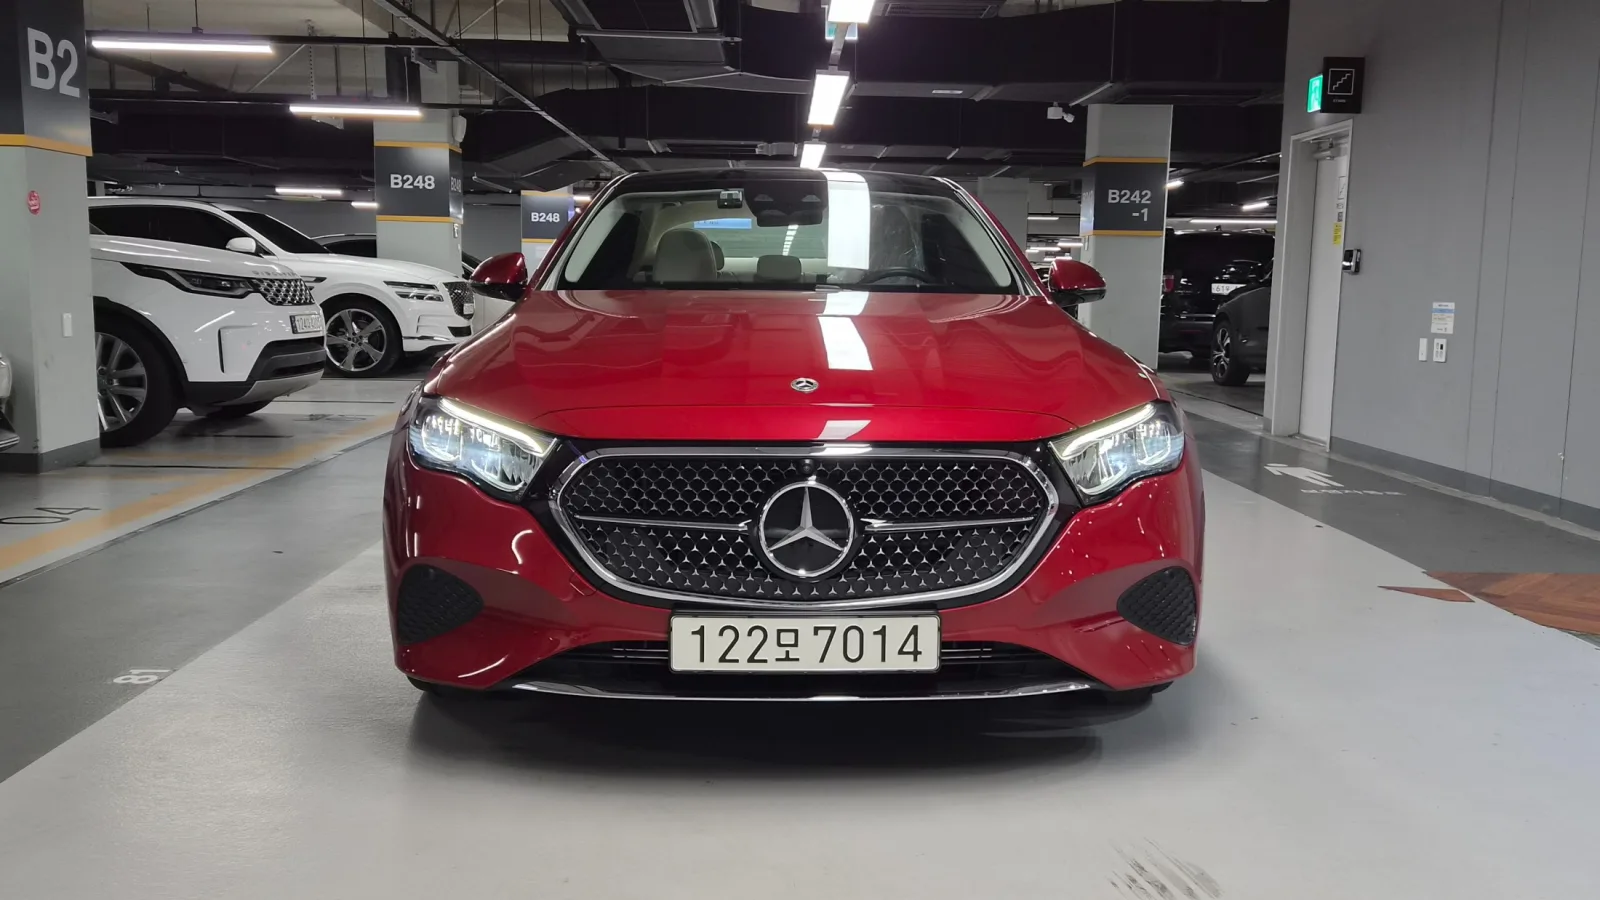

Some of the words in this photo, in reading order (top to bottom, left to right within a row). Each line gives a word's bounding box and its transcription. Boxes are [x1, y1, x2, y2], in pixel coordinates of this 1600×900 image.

[27, 26, 80, 98] B2
[390, 173, 436, 190] B248
[1107, 189, 1152, 204] B242
[531, 212, 560, 223] B248
[1132, 207, 1149, 222] -1
